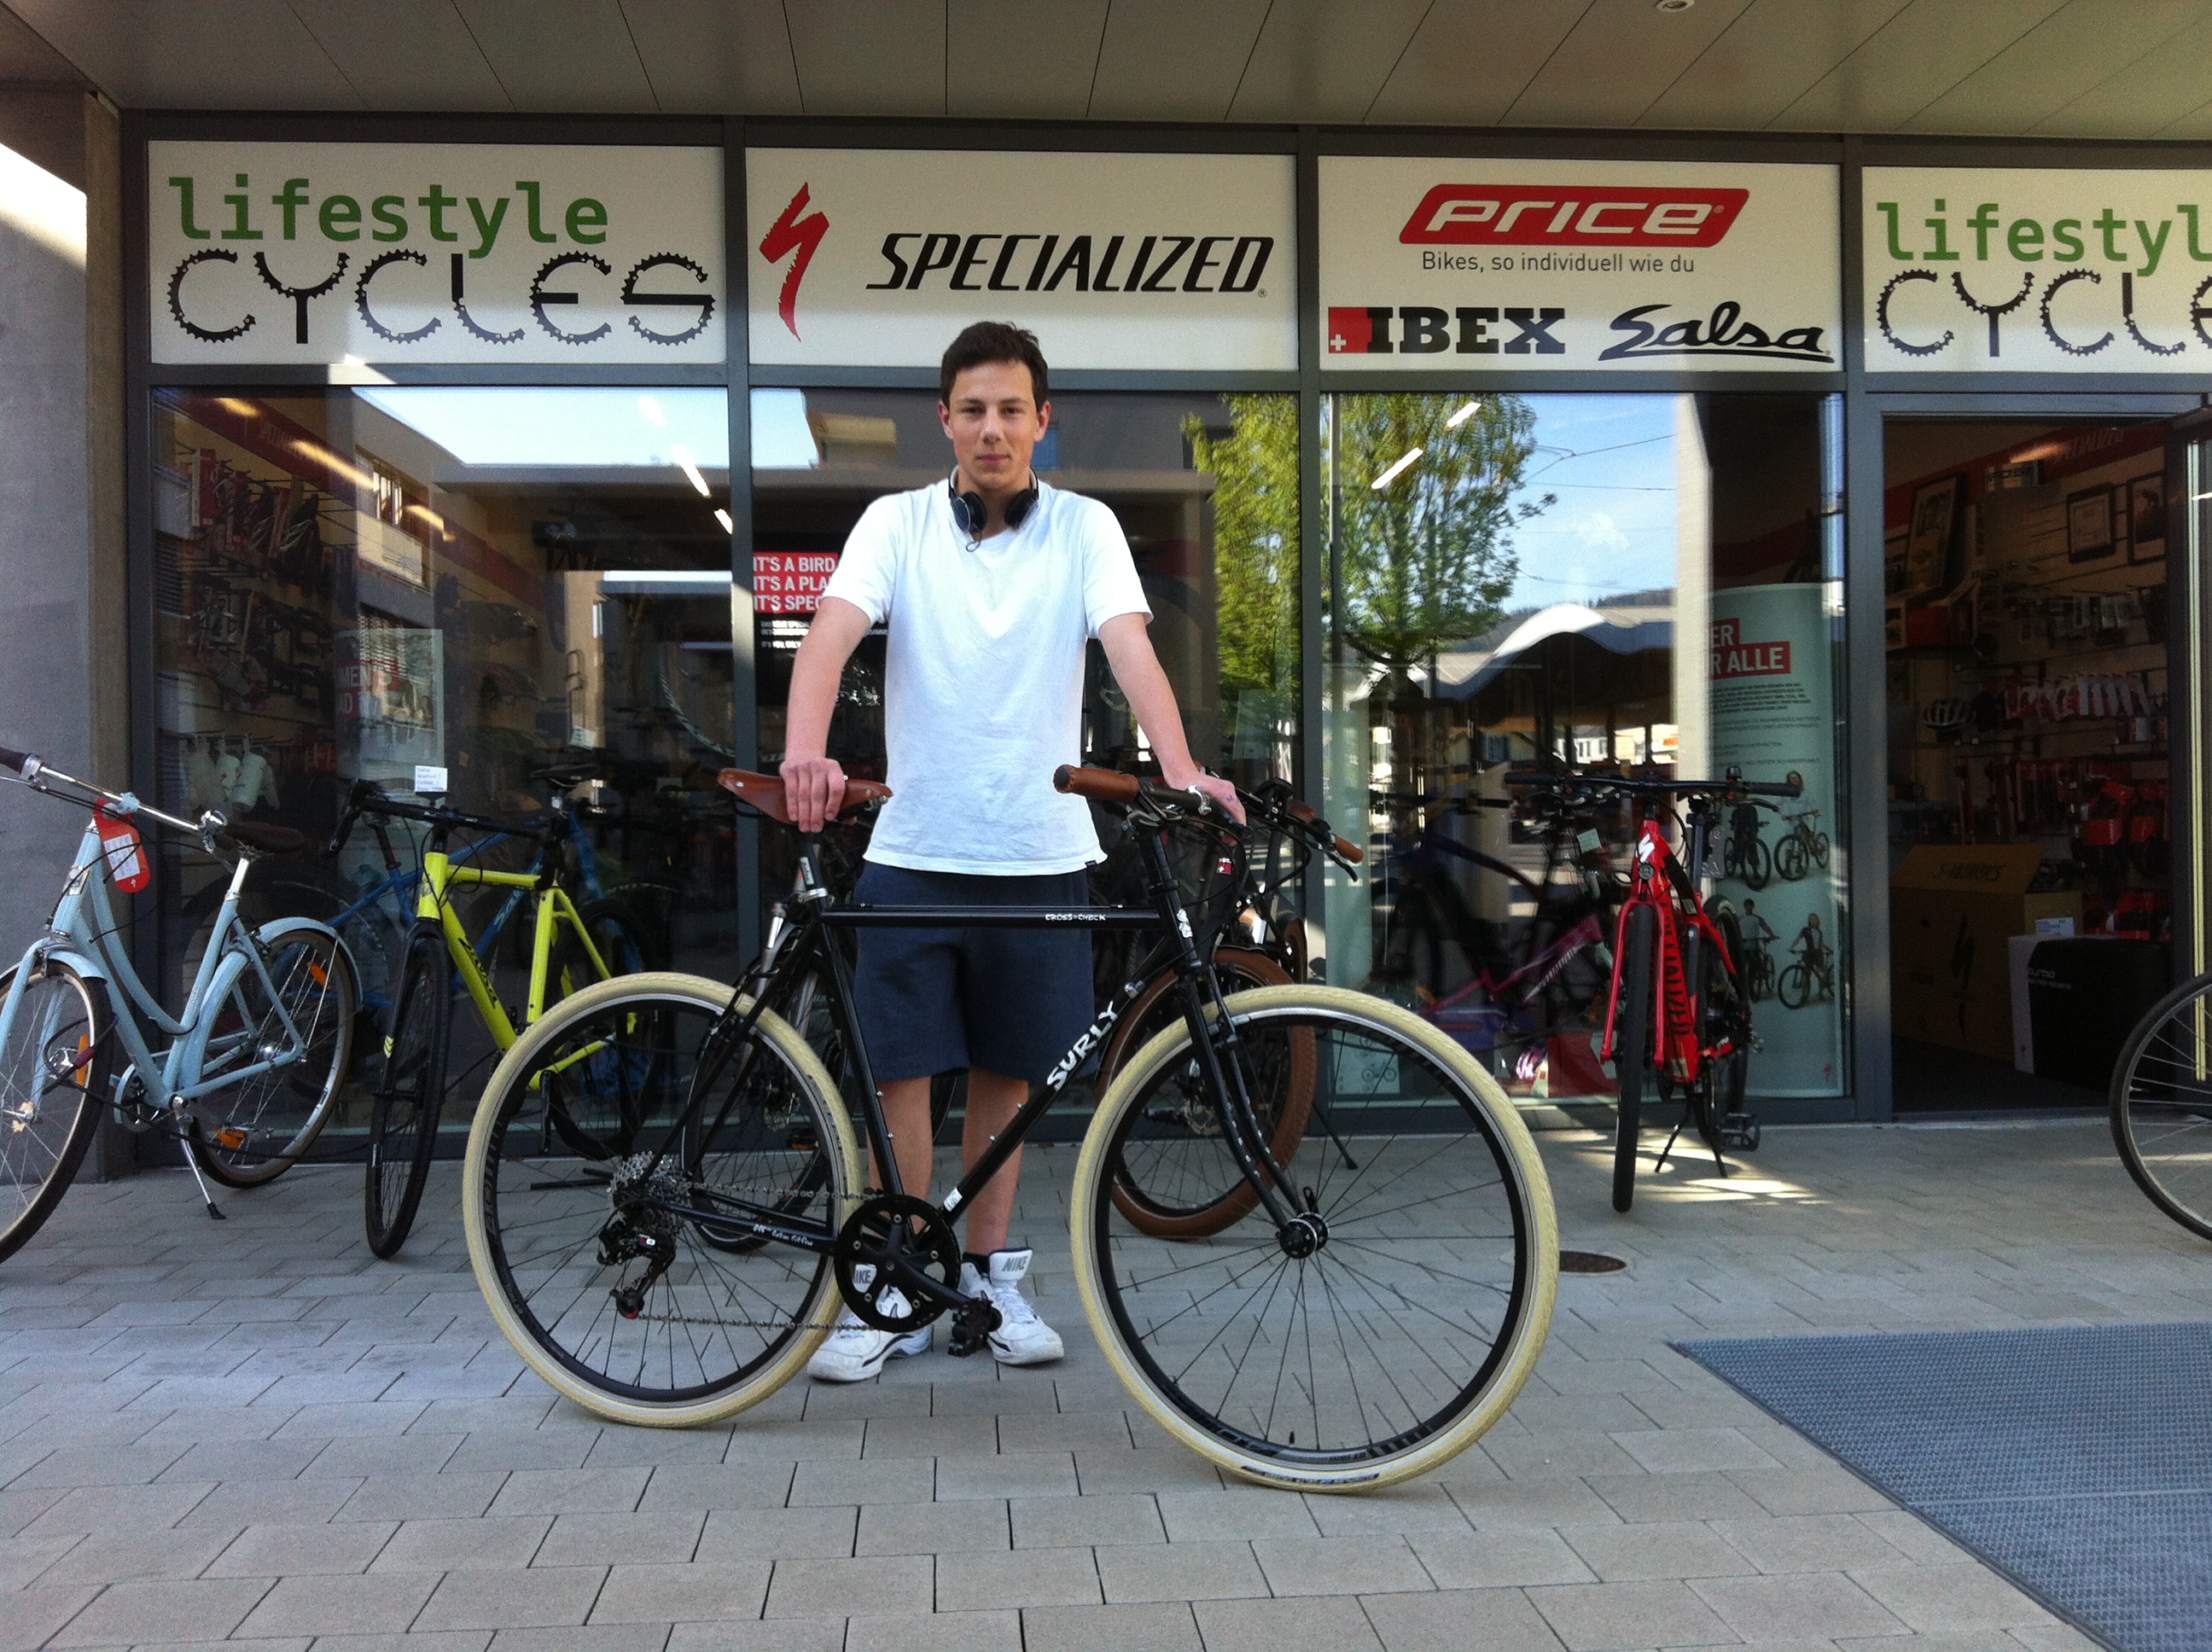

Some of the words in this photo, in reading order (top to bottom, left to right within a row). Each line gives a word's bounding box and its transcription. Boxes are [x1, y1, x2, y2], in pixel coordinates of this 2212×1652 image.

[168, 173, 608, 259] lifestyle
[1877, 199, 2212, 277] lifestyl
[866, 233, 1274, 294] SPECIALIZED
[1423, 252, 1485, 273] Bikes,
[1492, 255, 1514, 271] so
[1521, 253, 1622, 272] individuell
[1630, 254, 1664, 272] wie
[1671, 254, 1695, 273] du
[166, 247, 716, 346] CYCLES
[1367, 306, 1565, 354] IBEX
[1598, 301, 1835, 364] Salsa
[784, 556, 795, 573] A
[784, 576, 795, 591] A
[799, 576, 830, 591] PLA
[1727, 647, 1784, 673] ALLE
[1047, 1000, 1118, 1091] SURLY
[1001, 1256, 1028, 1272] NIKE
